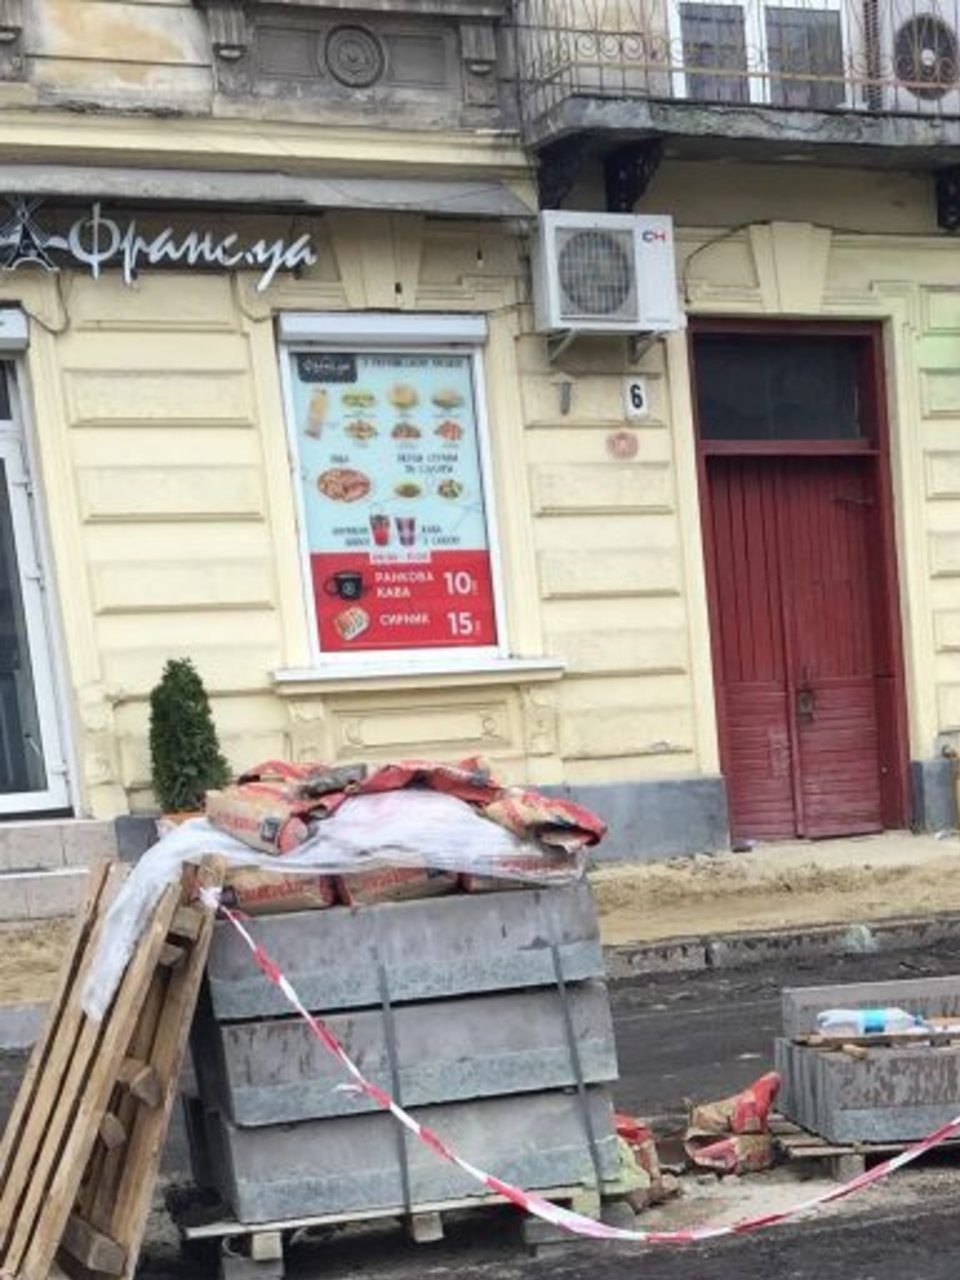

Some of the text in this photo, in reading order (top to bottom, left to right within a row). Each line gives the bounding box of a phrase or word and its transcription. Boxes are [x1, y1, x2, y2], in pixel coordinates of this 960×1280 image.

[629, 384, 644, 410] 6
[374, 571, 435, 583] РАНКОВА
[443, 571, 472, 595] 10
[376, 586, 411, 599] КАВА
[379, 613, 430, 626] СИРНИК
[446, 611, 473, 636] 15
